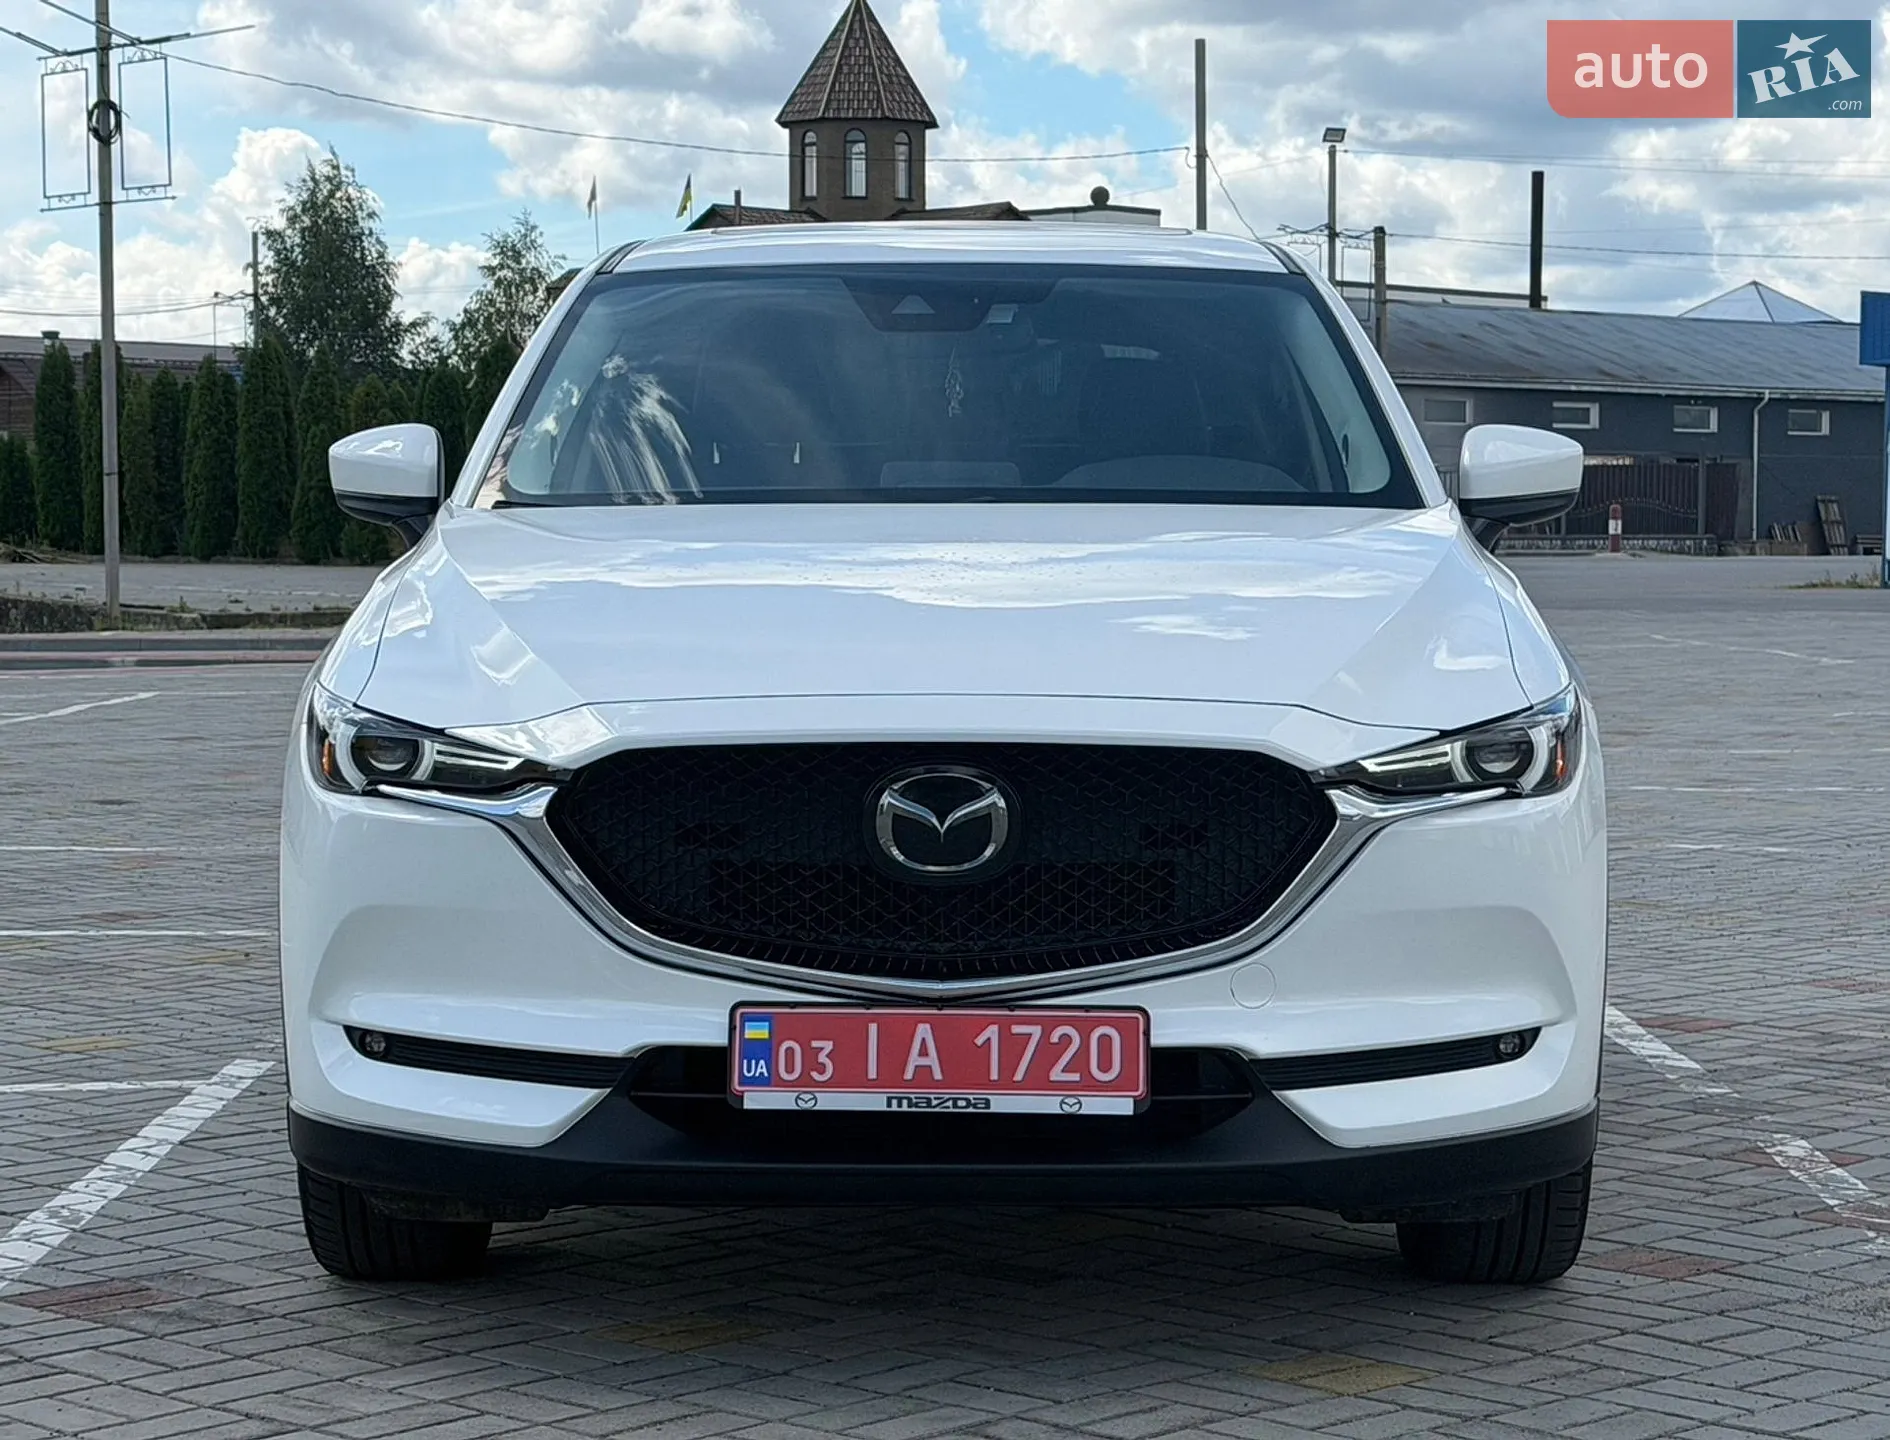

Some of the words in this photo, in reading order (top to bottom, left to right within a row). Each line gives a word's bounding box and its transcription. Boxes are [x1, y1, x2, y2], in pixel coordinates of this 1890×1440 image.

[743, 1059, 768, 1077] UA
[777, 1040, 834, 1082] 03
[973, 1024, 1122, 1083] 1720
